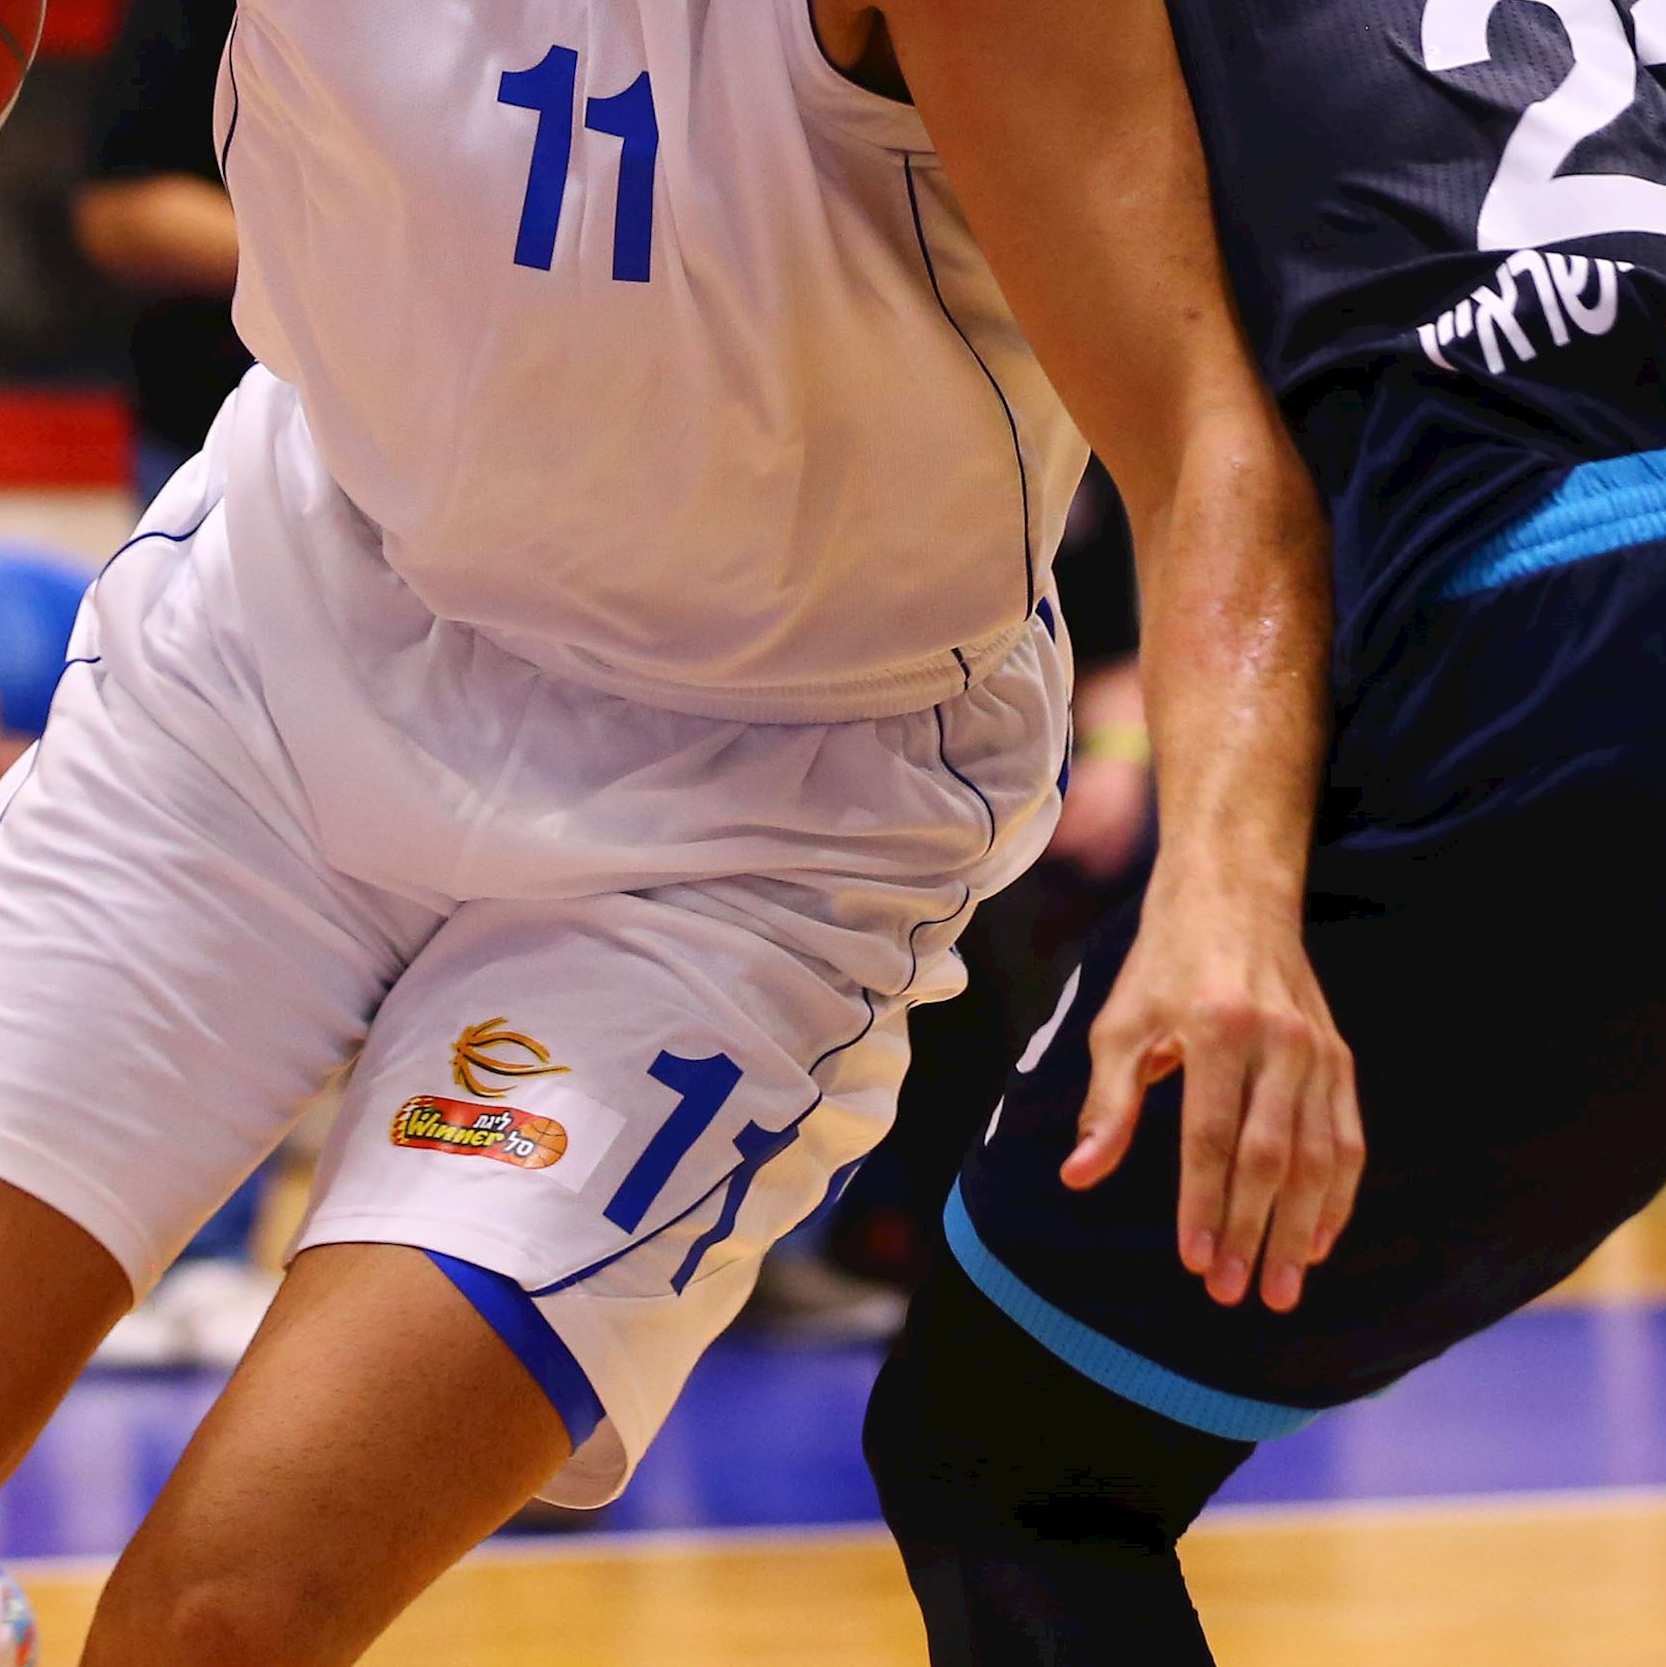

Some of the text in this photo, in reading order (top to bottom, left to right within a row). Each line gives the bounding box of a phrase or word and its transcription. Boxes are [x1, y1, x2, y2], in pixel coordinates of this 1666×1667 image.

[496, 44, 660, 283] 11
[407, 1108, 506, 1147] Winner
[473, 1110, 513, 1130] ליגת
[503, 1131, 534, 1157] סל
[603, 1048, 802, 1297] 11
